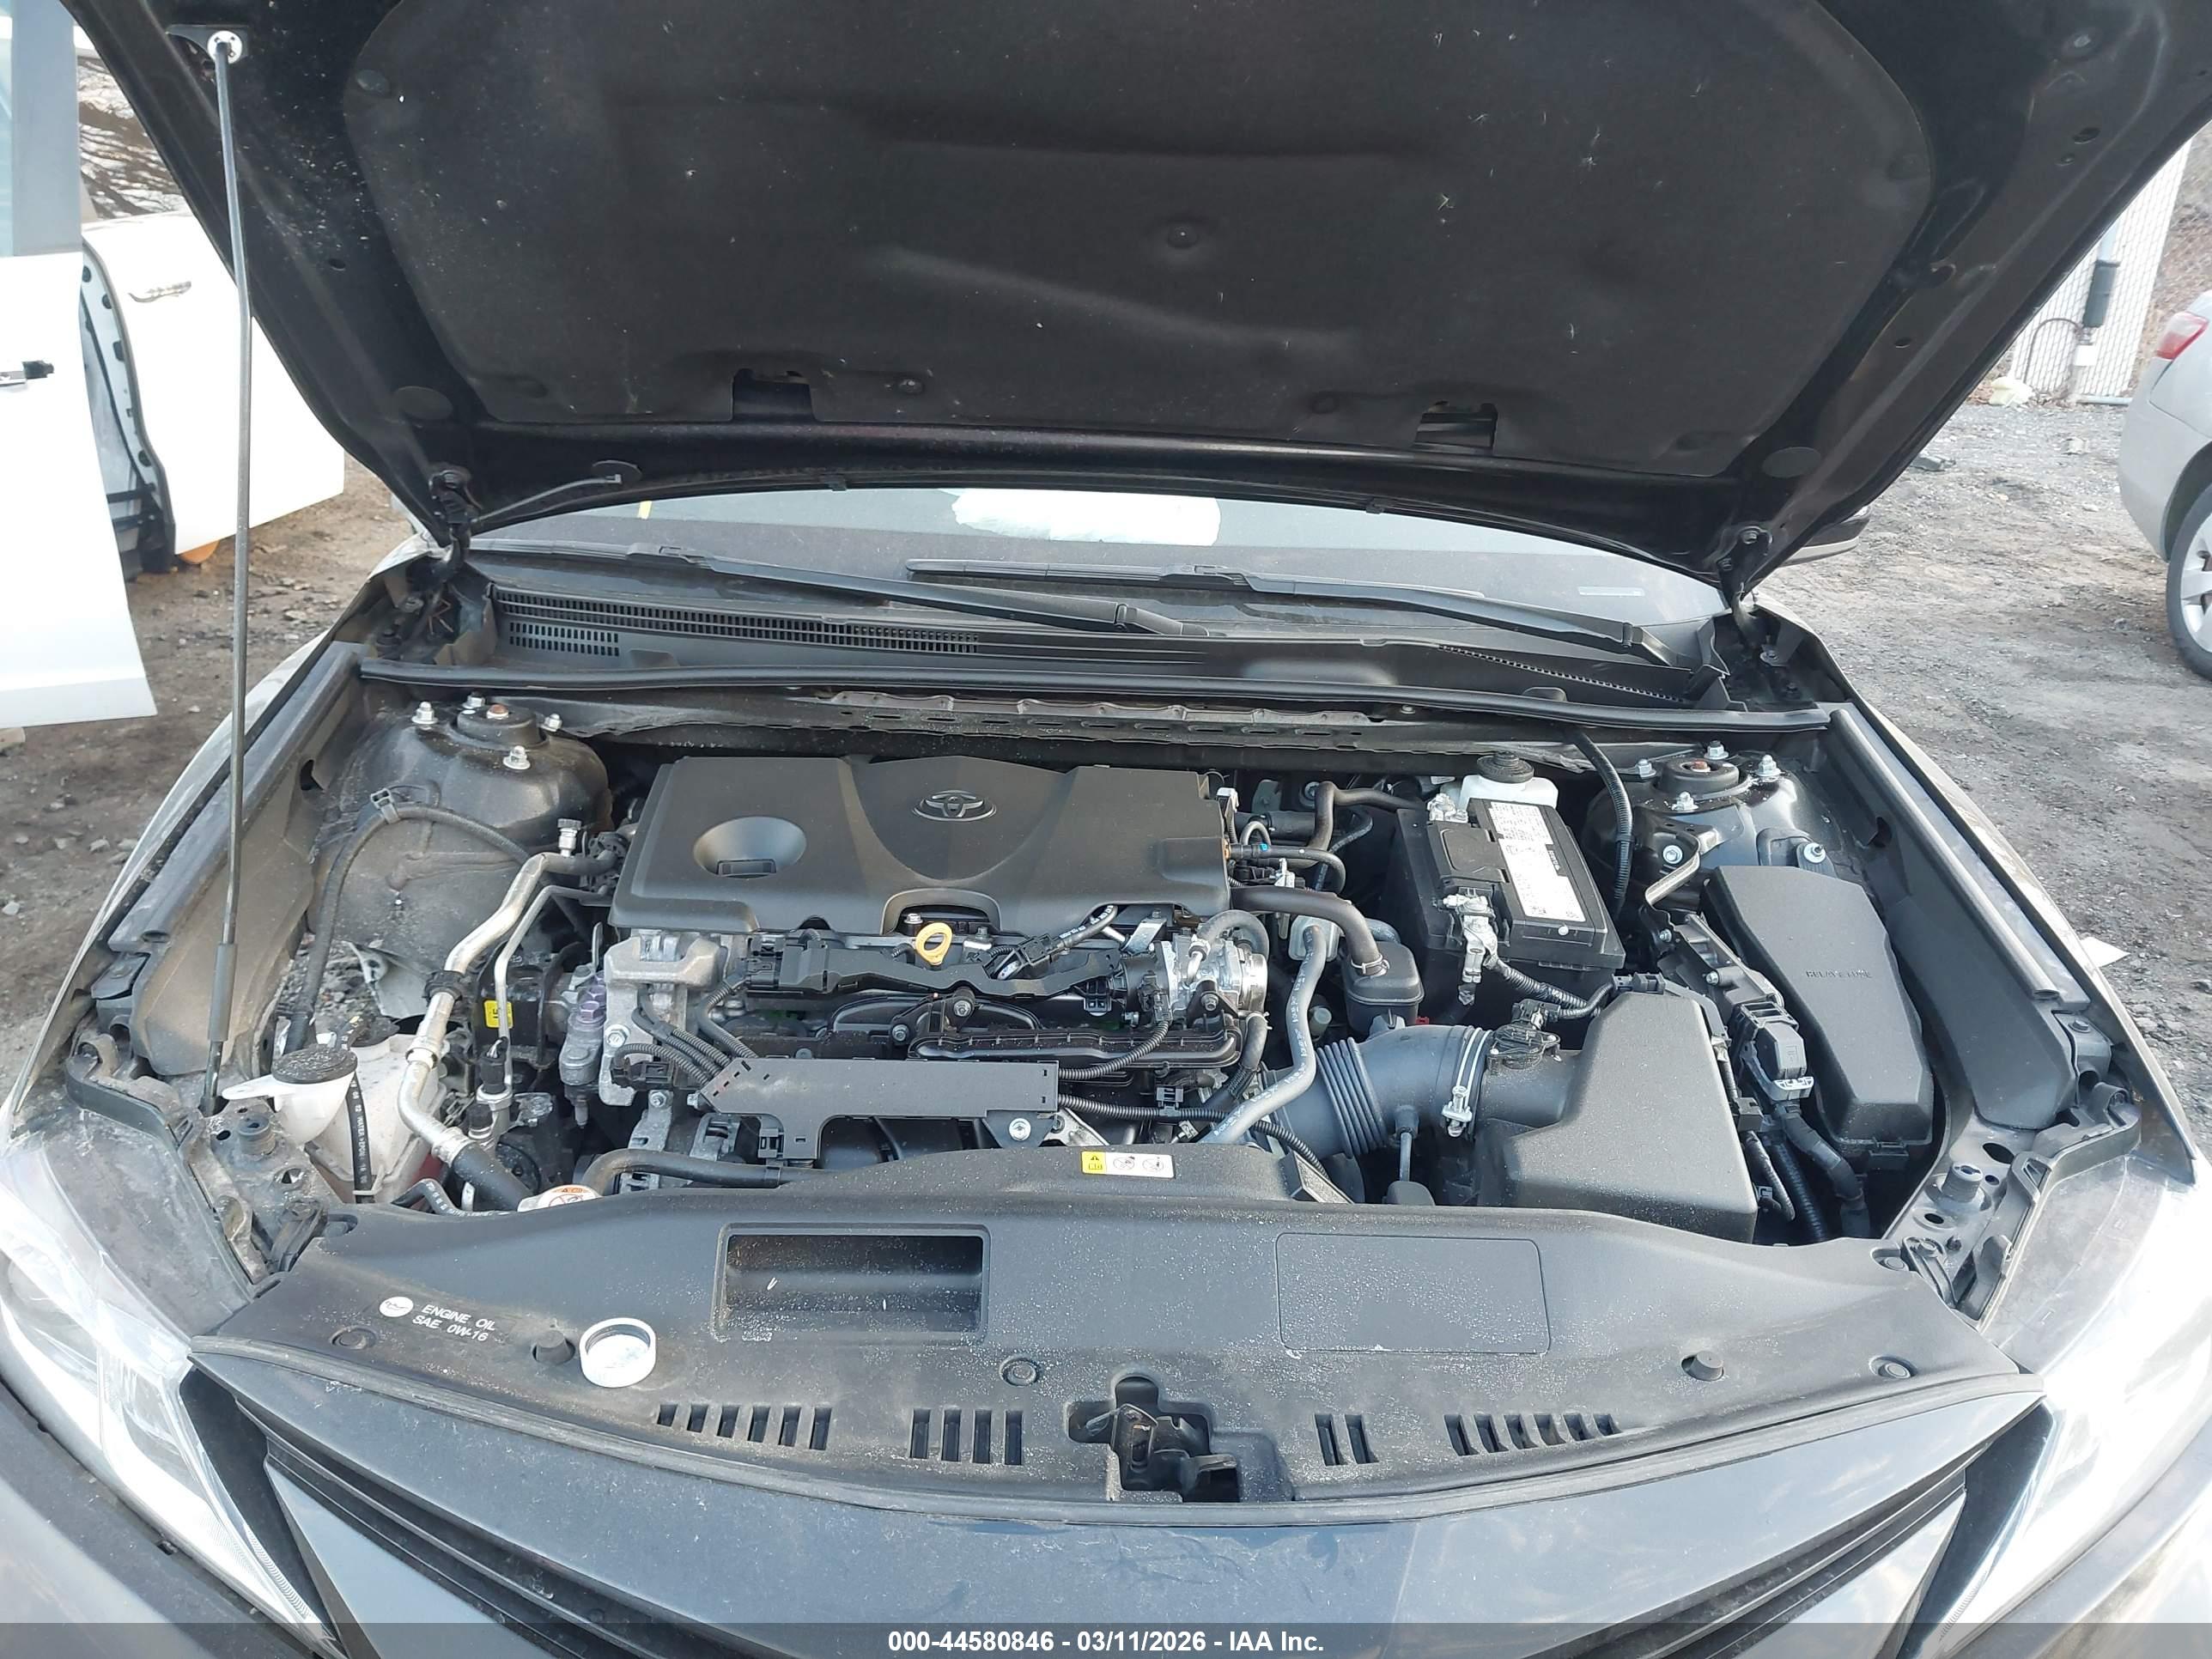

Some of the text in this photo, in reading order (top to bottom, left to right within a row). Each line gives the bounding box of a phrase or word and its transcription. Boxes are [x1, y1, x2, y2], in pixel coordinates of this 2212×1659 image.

[412, 1315, 489, 1341] SAE 0W-16
[422, 1304, 495, 1331] ENGINE OIL
